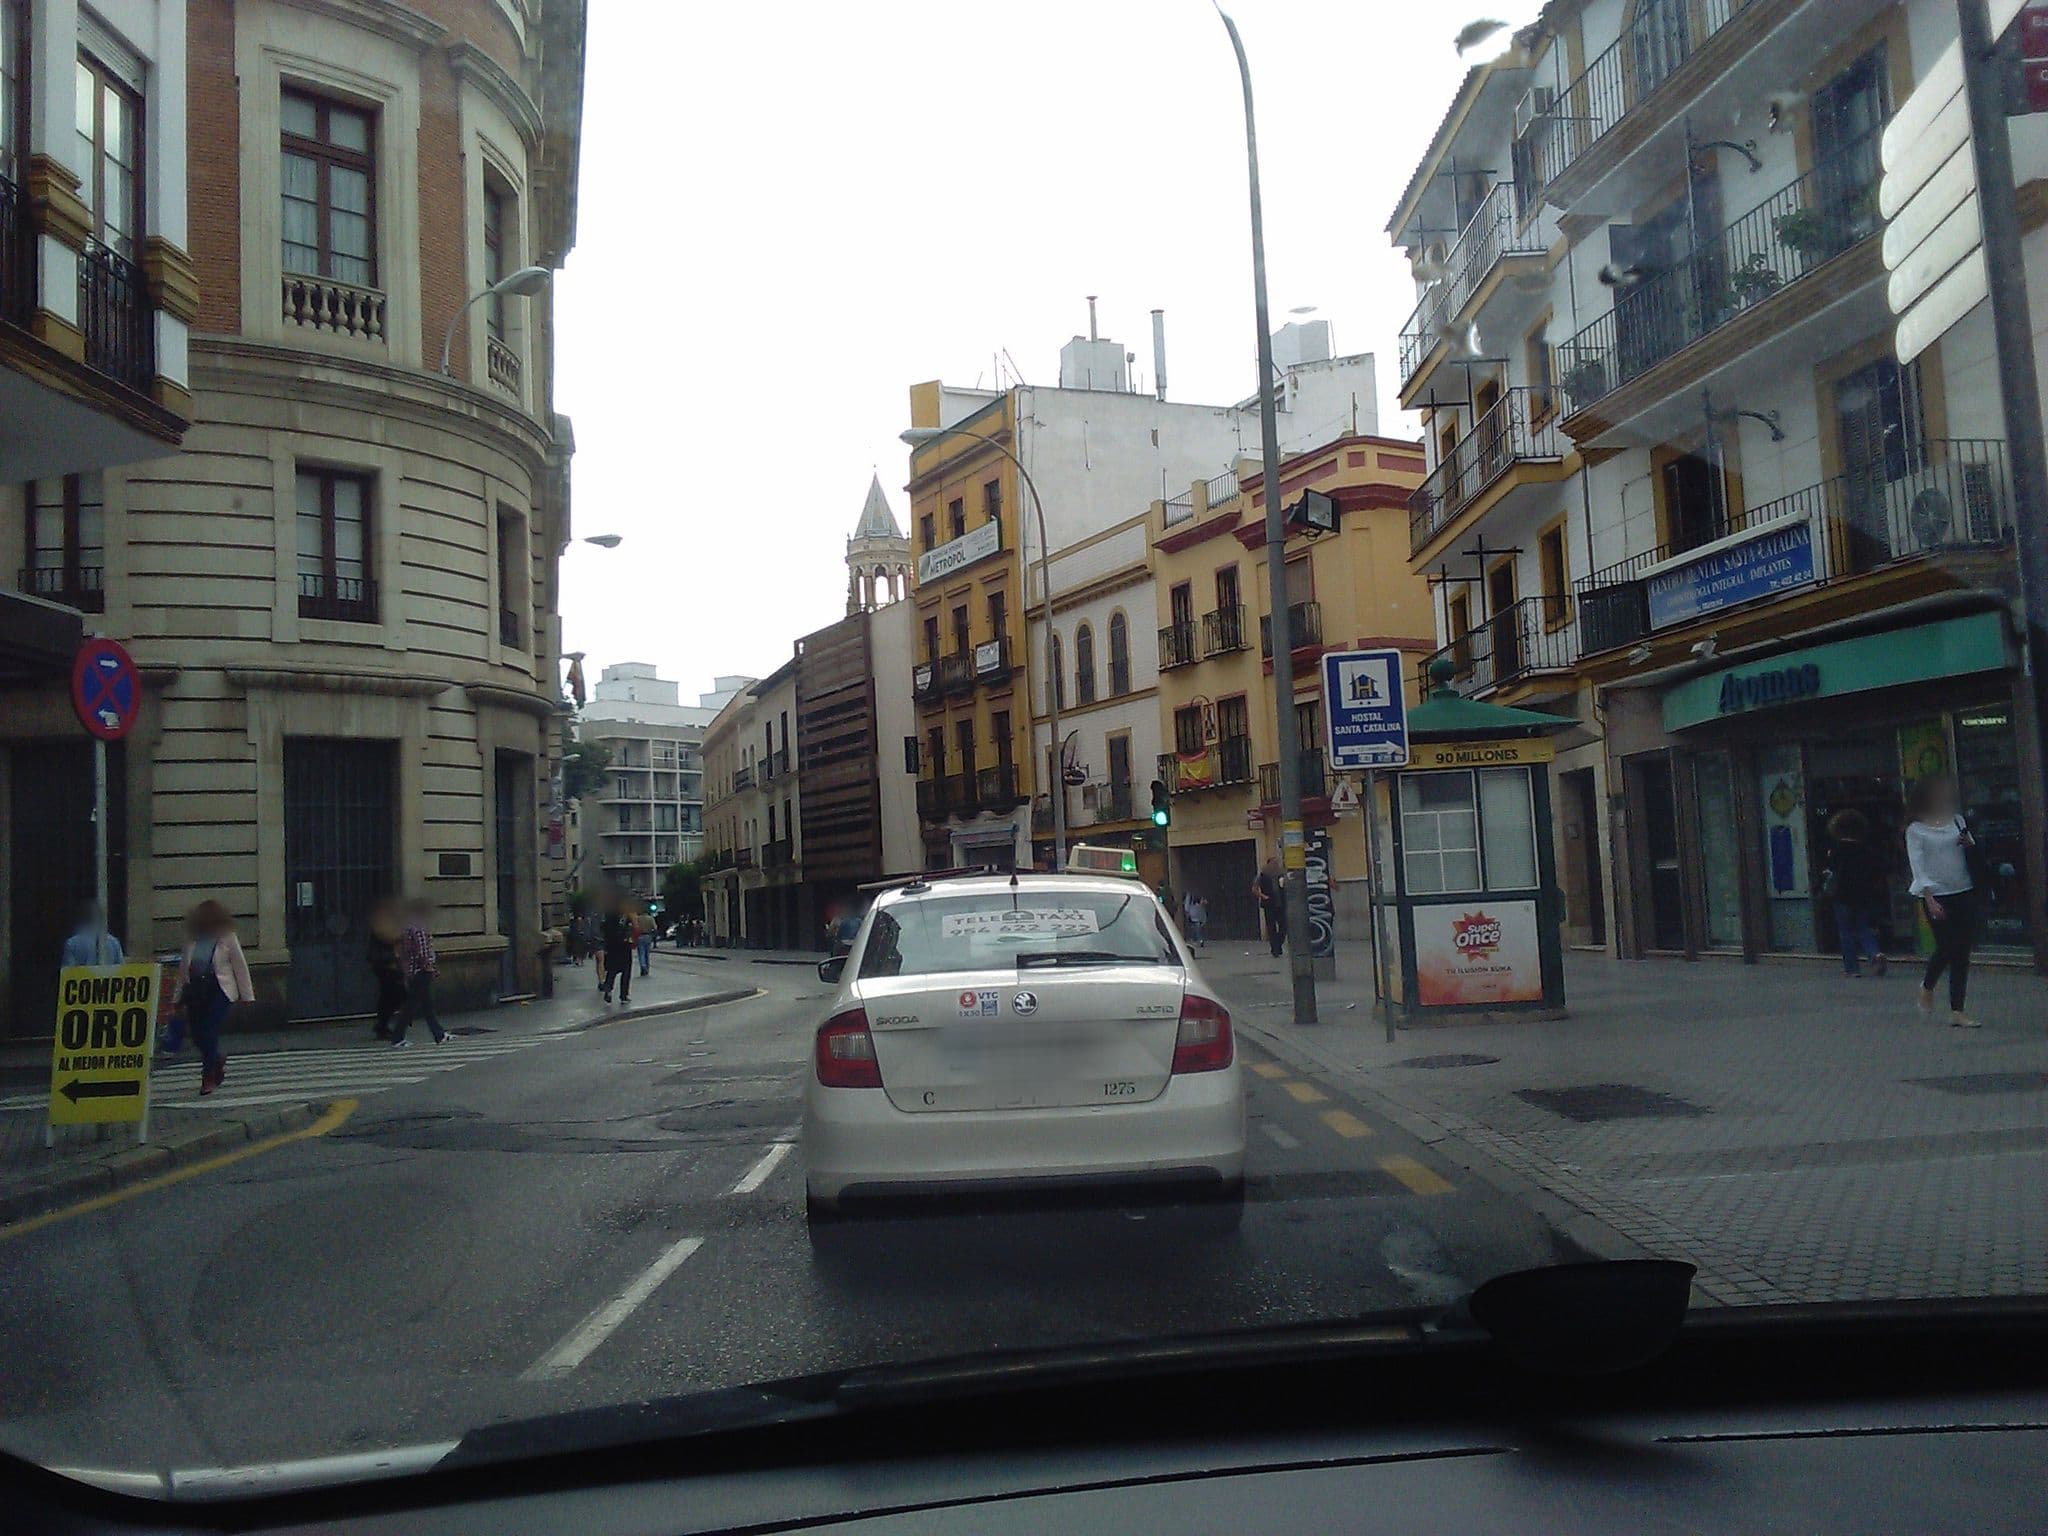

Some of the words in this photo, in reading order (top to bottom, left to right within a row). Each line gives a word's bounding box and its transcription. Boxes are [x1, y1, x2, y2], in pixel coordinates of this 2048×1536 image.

[1351, 712, 1383, 722] HOSTAL
[1335, 725, 1361, 735] SANTA
[1363, 722, 1400, 733] CATALINA
[1435, 752, 1454, 764] 90
[1456, 748, 1518, 762] MILLONES
[954, 914, 1000, 925] TELE
[1036, 912, 1085, 921] TAXI
[1456, 930, 1501, 948] Once
[64, 976, 150, 1006] COMPRO
[977, 991, 999, 999] VTC
[62, 1007, 148, 1050] ORO
[58, 1057, 70, 1071] AL
[72, 1055, 105, 1070] MEJOR
[108, 1053, 144, 1069] PRECIO
[1103, 1081, 1136, 1096] 1275
[923, 1091, 935, 1106] C
